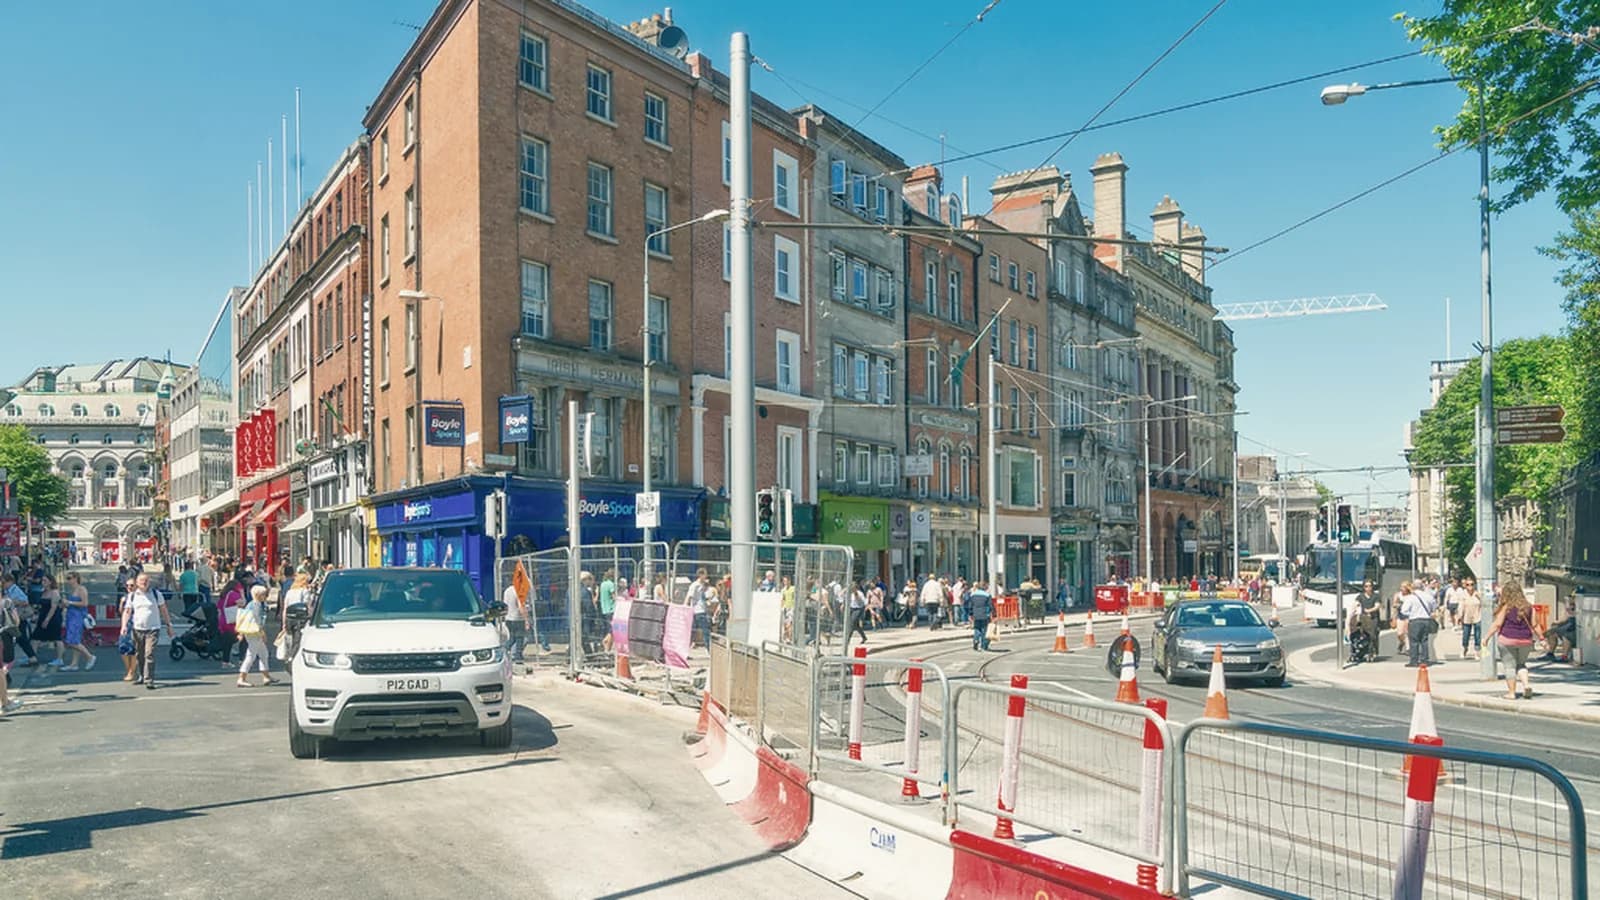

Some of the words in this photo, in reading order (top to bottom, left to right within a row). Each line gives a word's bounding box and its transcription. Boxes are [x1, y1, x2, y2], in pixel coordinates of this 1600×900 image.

[590, 367, 658, 388] PERMANET
[431, 418, 461, 430] Boyle
[505, 414, 528, 427] Boyle
[255, 421, 263, 468] AVOCA
[263, 415, 273, 464] AVOCA
[243, 428, 253, 473] AVOCA
[407, 679, 429, 690] GAD
